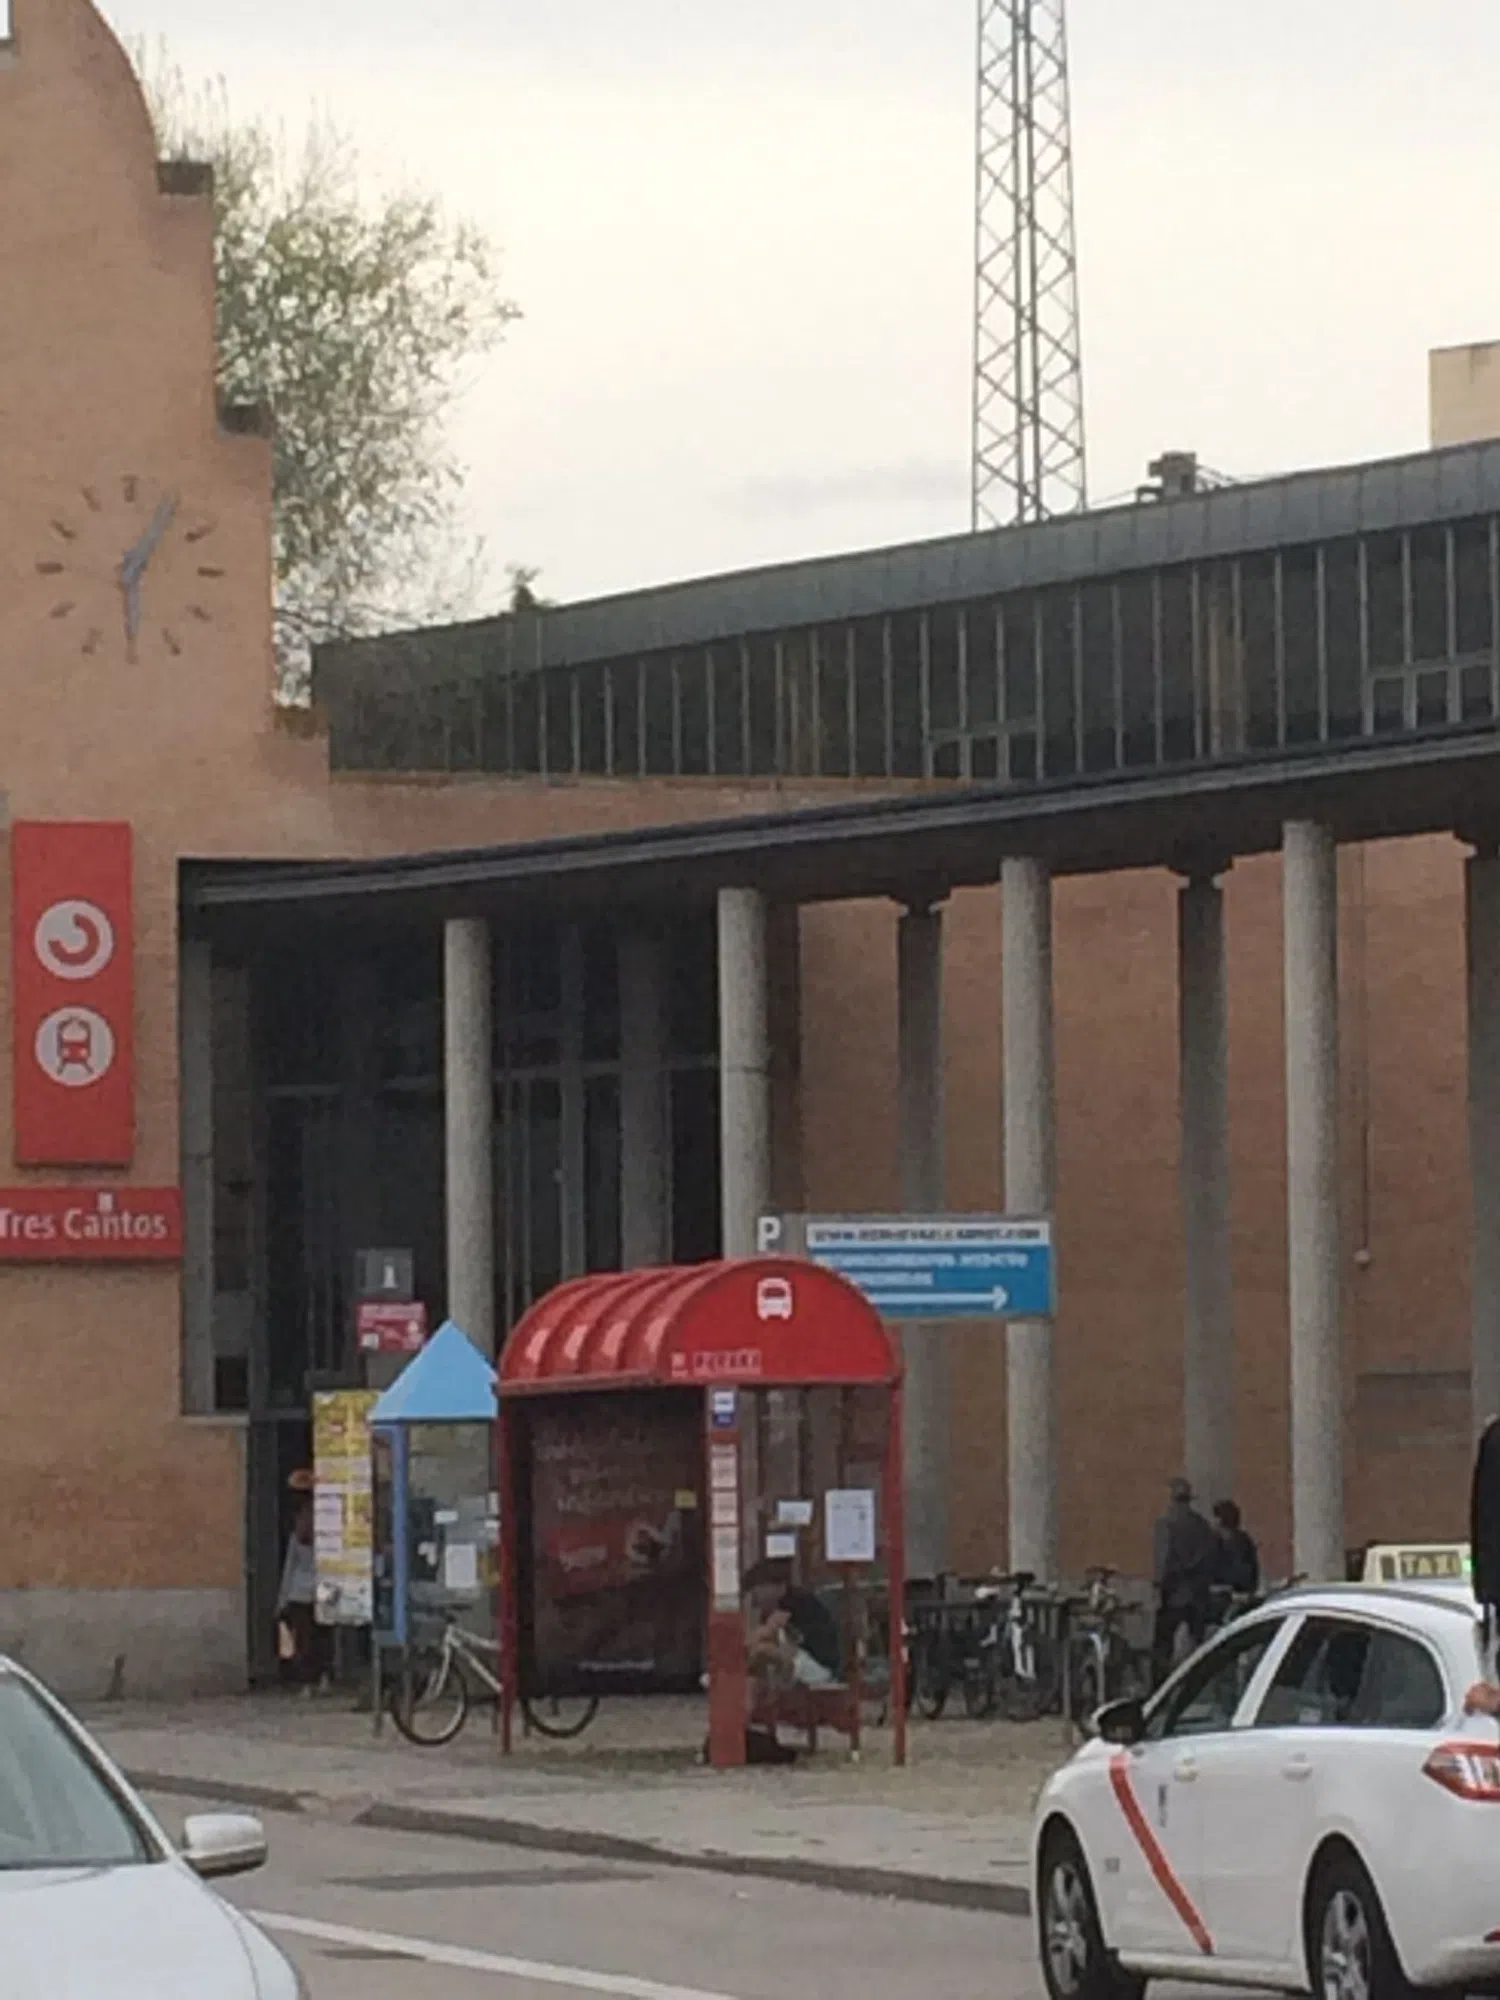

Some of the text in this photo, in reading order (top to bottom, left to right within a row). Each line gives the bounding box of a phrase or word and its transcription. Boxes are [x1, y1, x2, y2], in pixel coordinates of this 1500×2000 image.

[0, 1207, 168, 1240] Tres Cantos
[757, 1216, 781, 1251] P
[1401, 1552, 1461, 1576] TAXI
